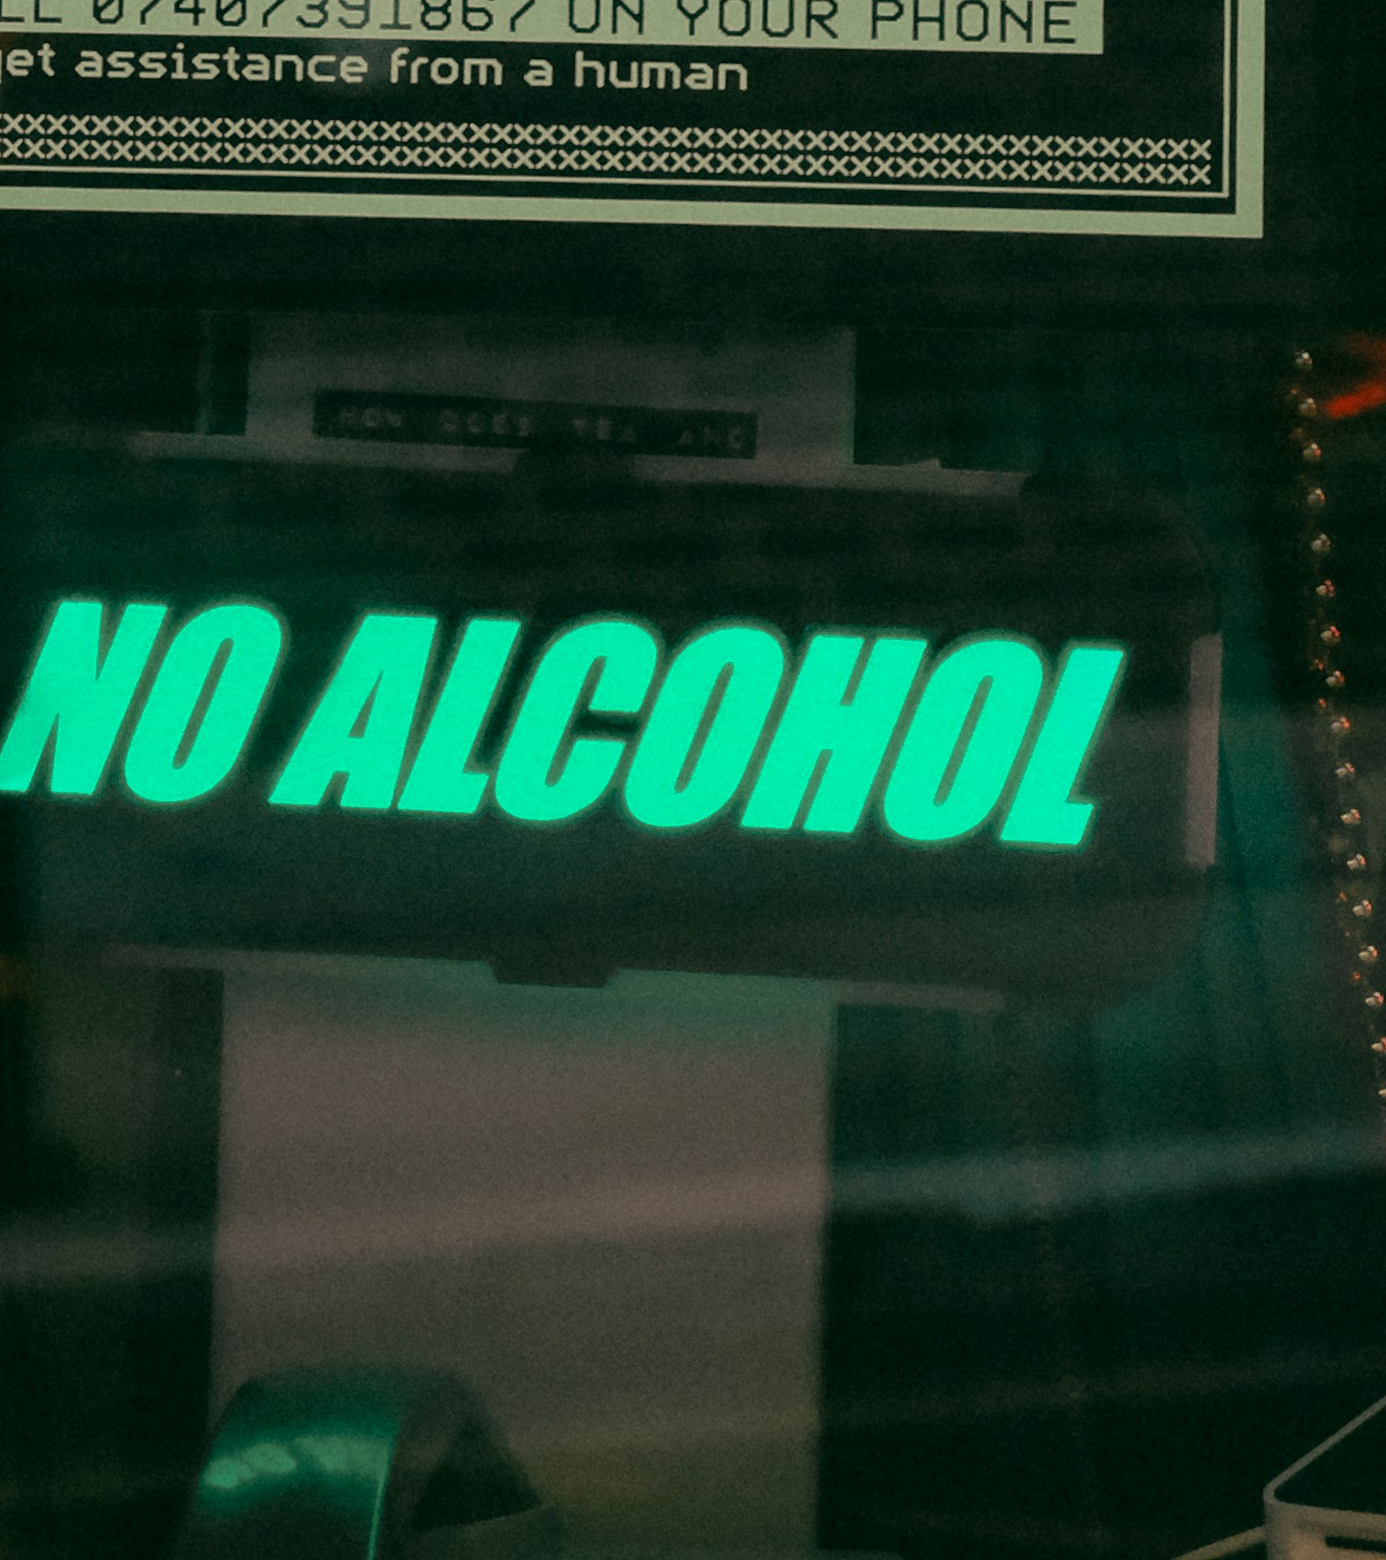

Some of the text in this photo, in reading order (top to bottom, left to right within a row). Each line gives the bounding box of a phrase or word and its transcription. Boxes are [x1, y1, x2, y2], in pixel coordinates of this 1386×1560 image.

[74, 42, 370, 84] assistance
[389, 46, 504, 86] from
[523, 58, 554, 87] a
[573, 49, 749, 92] human
[265, 609, 1124, 847] ALCOHOL
